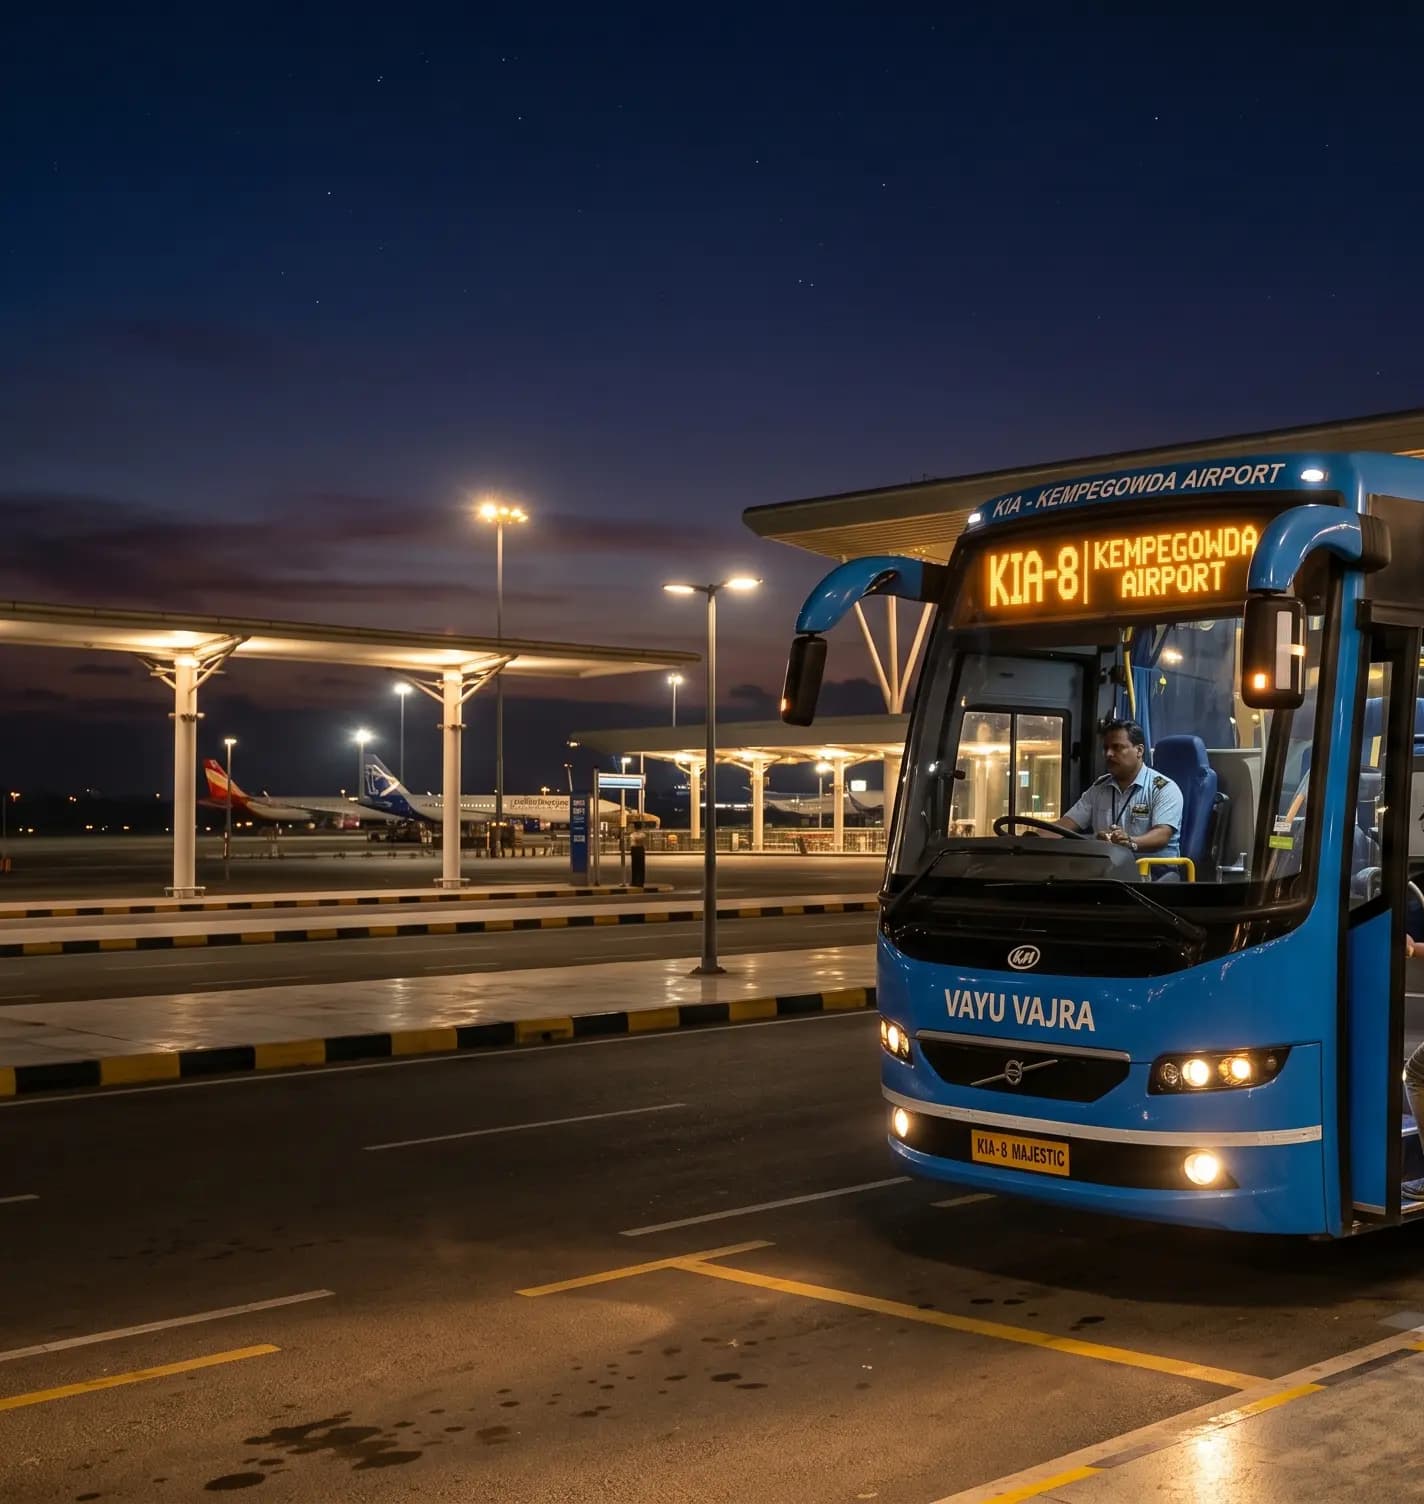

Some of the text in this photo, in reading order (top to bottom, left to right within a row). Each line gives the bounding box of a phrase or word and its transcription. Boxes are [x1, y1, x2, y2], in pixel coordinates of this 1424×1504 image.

[993, 494, 1022, 518] KIA
[1035, 471, 1177, 509] KEMPEGOWDA
[1180, 463, 1286, 489] AIRPORT
[988, 524, 1259, 607] KIA-8 KEMPEGOWDA
[1120, 560, 1227, 599] AIRPORT
[944, 988, 1096, 1032] VAYU VAJRA
[977, 1137, 1065, 1167] KIA-8 MAJESTIC
